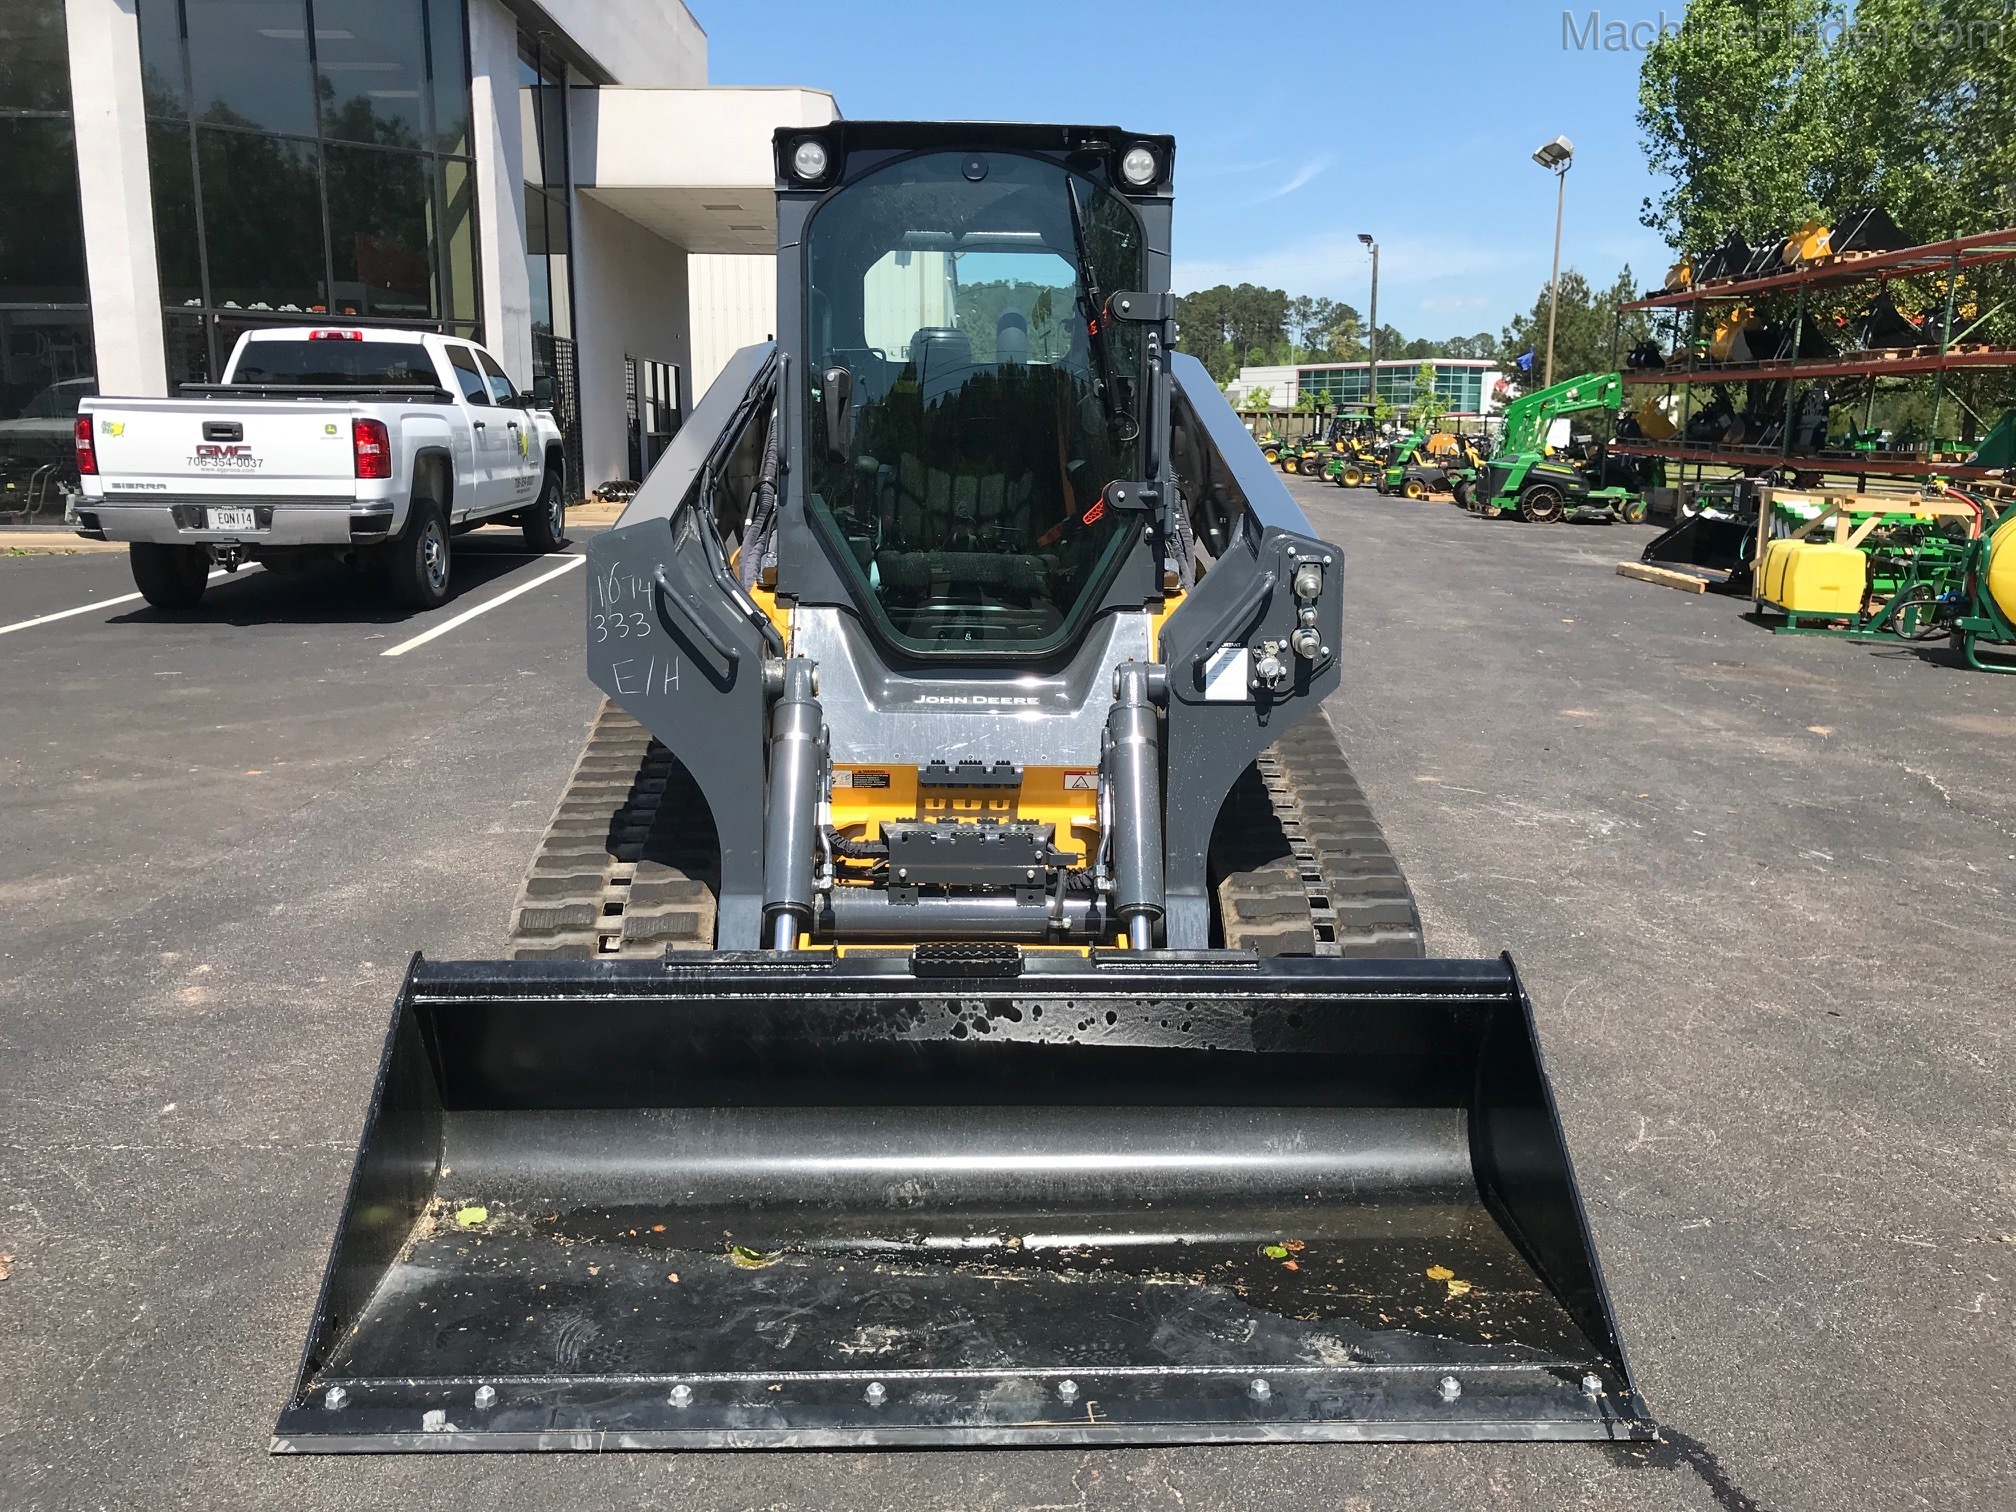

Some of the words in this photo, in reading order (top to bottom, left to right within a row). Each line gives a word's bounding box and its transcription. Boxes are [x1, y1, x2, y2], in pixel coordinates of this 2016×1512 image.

[196, 445, 252, 459] GMC
[186, 456, 264, 468] 706-354-0037
[217, 512, 252, 524] EQN114
[597, 561, 653, 611] 1674
[594, 612, 651, 643] 333
[613, 655, 680, 697] E/H
[914, 695, 968, 704] JOHN
[972, 696, 1039, 705] DEERE
